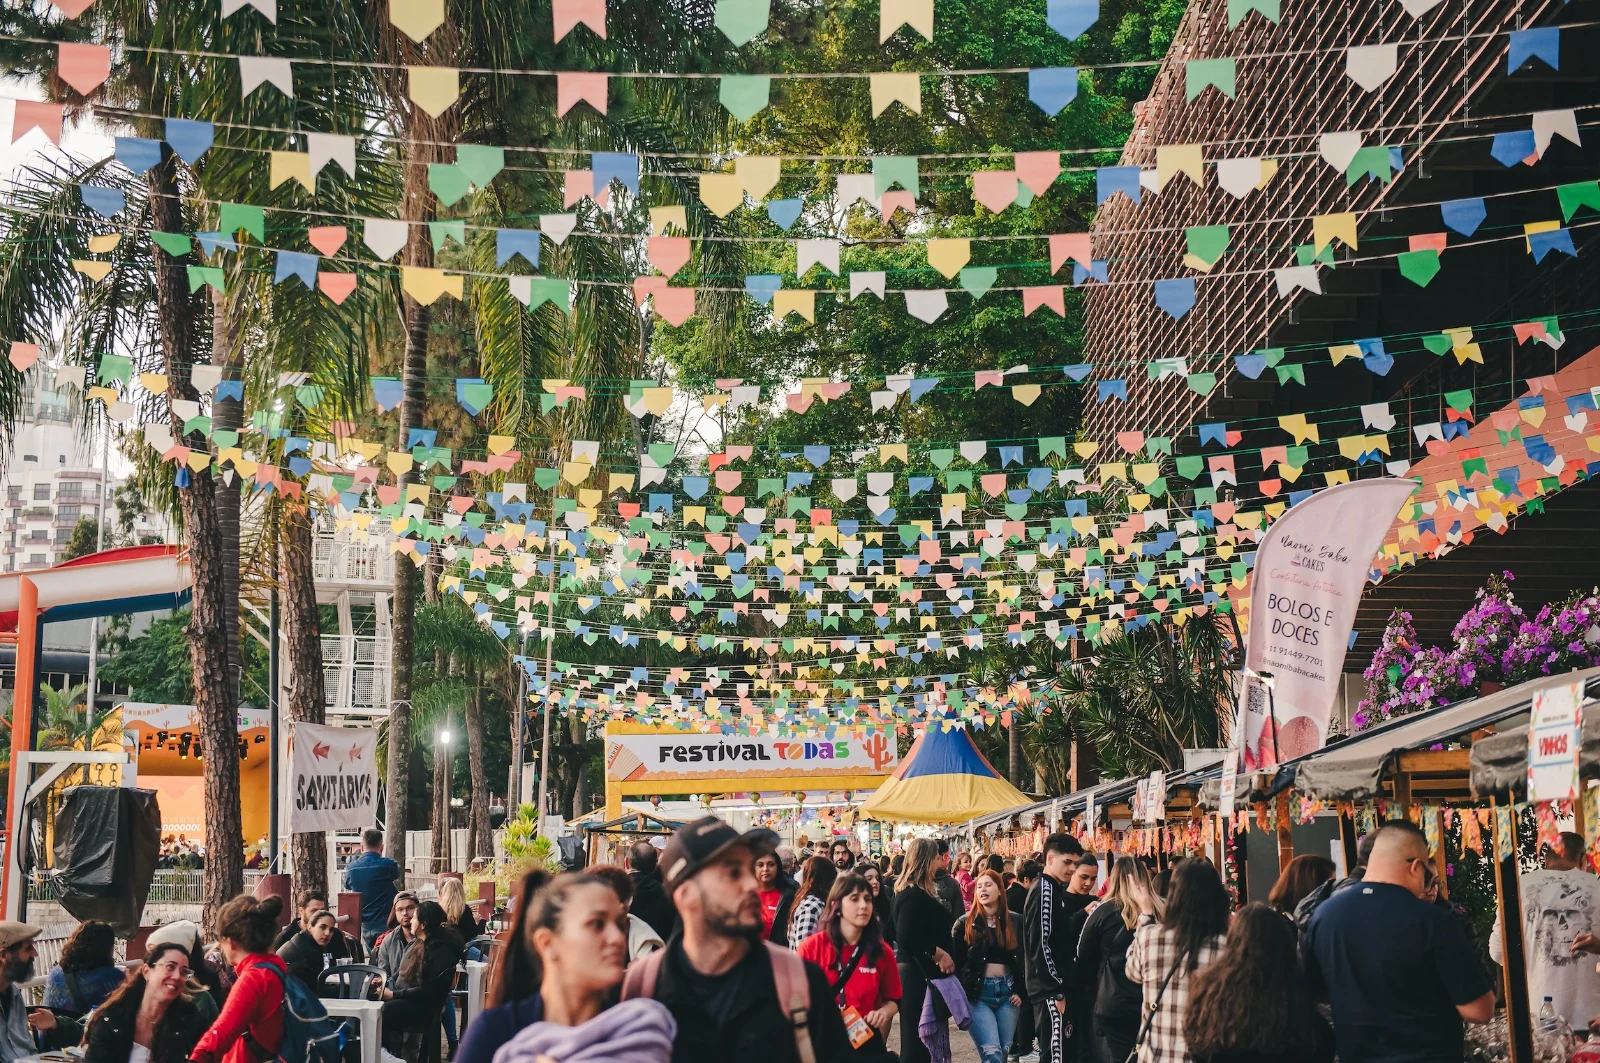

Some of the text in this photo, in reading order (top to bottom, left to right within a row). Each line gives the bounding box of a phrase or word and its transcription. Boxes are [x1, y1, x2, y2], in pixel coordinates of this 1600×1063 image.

[1280, 534, 1352, 565] Naomi Baba
[1301, 556, 1326, 573] CAKES
[1267, 593, 1334, 627] BOLOS E
[1271, 620, 1320, 646] DOCES
[1262, 656, 1326, 682] @naomibabacakes
[1269, 645, 1324, 667] 11 91449-7701
[1539, 734, 1568, 757] VINHOS
